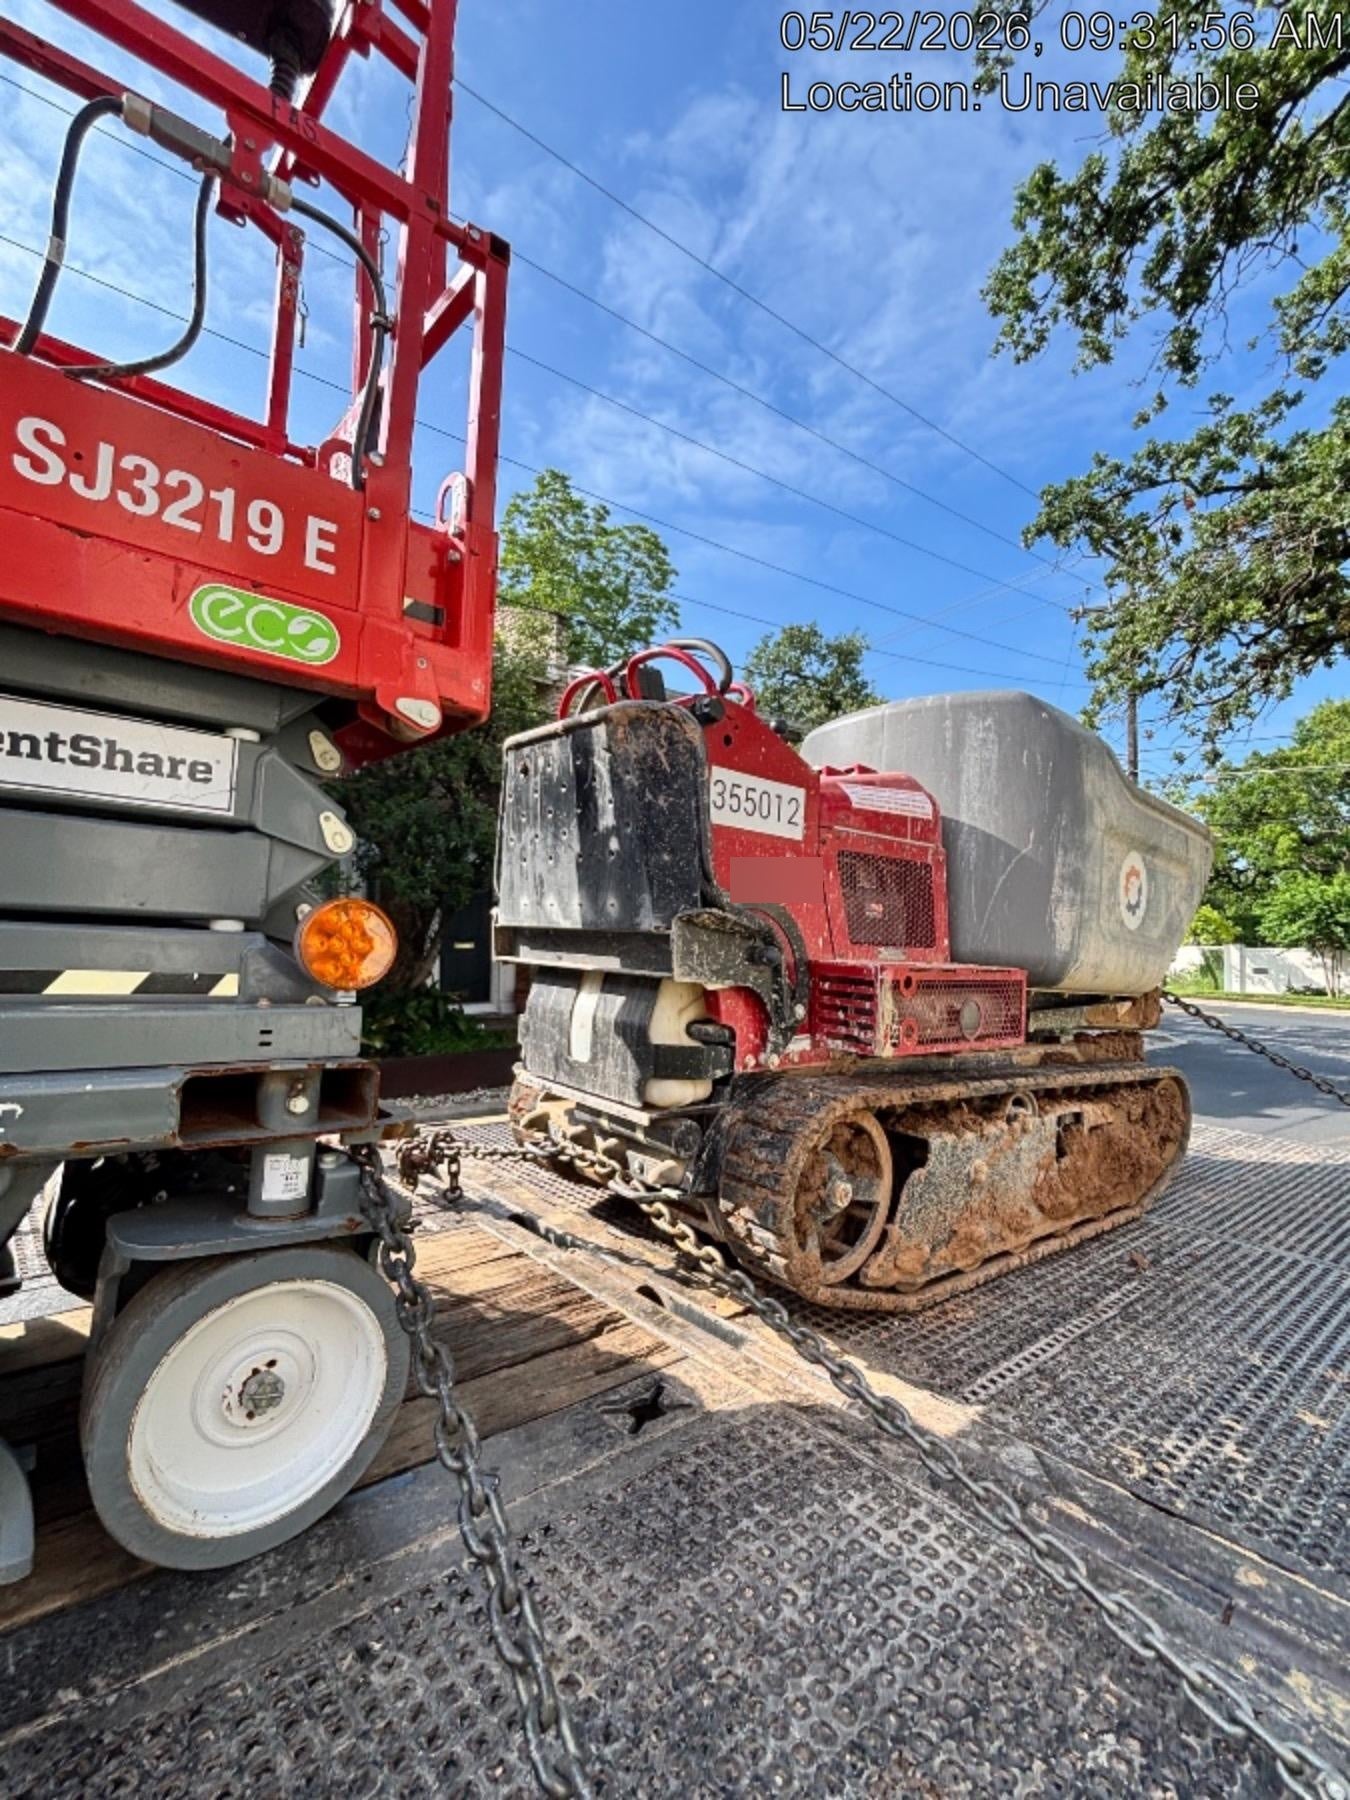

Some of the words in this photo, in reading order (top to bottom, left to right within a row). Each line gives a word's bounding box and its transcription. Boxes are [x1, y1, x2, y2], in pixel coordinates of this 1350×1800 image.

[12, 416, 284, 555] SJ3219
[304, 515, 338, 575] E
[201, 591, 331, 658] eco
[0, 730, 213, 784] ntShare
[712, 779, 800, 827] 355012
